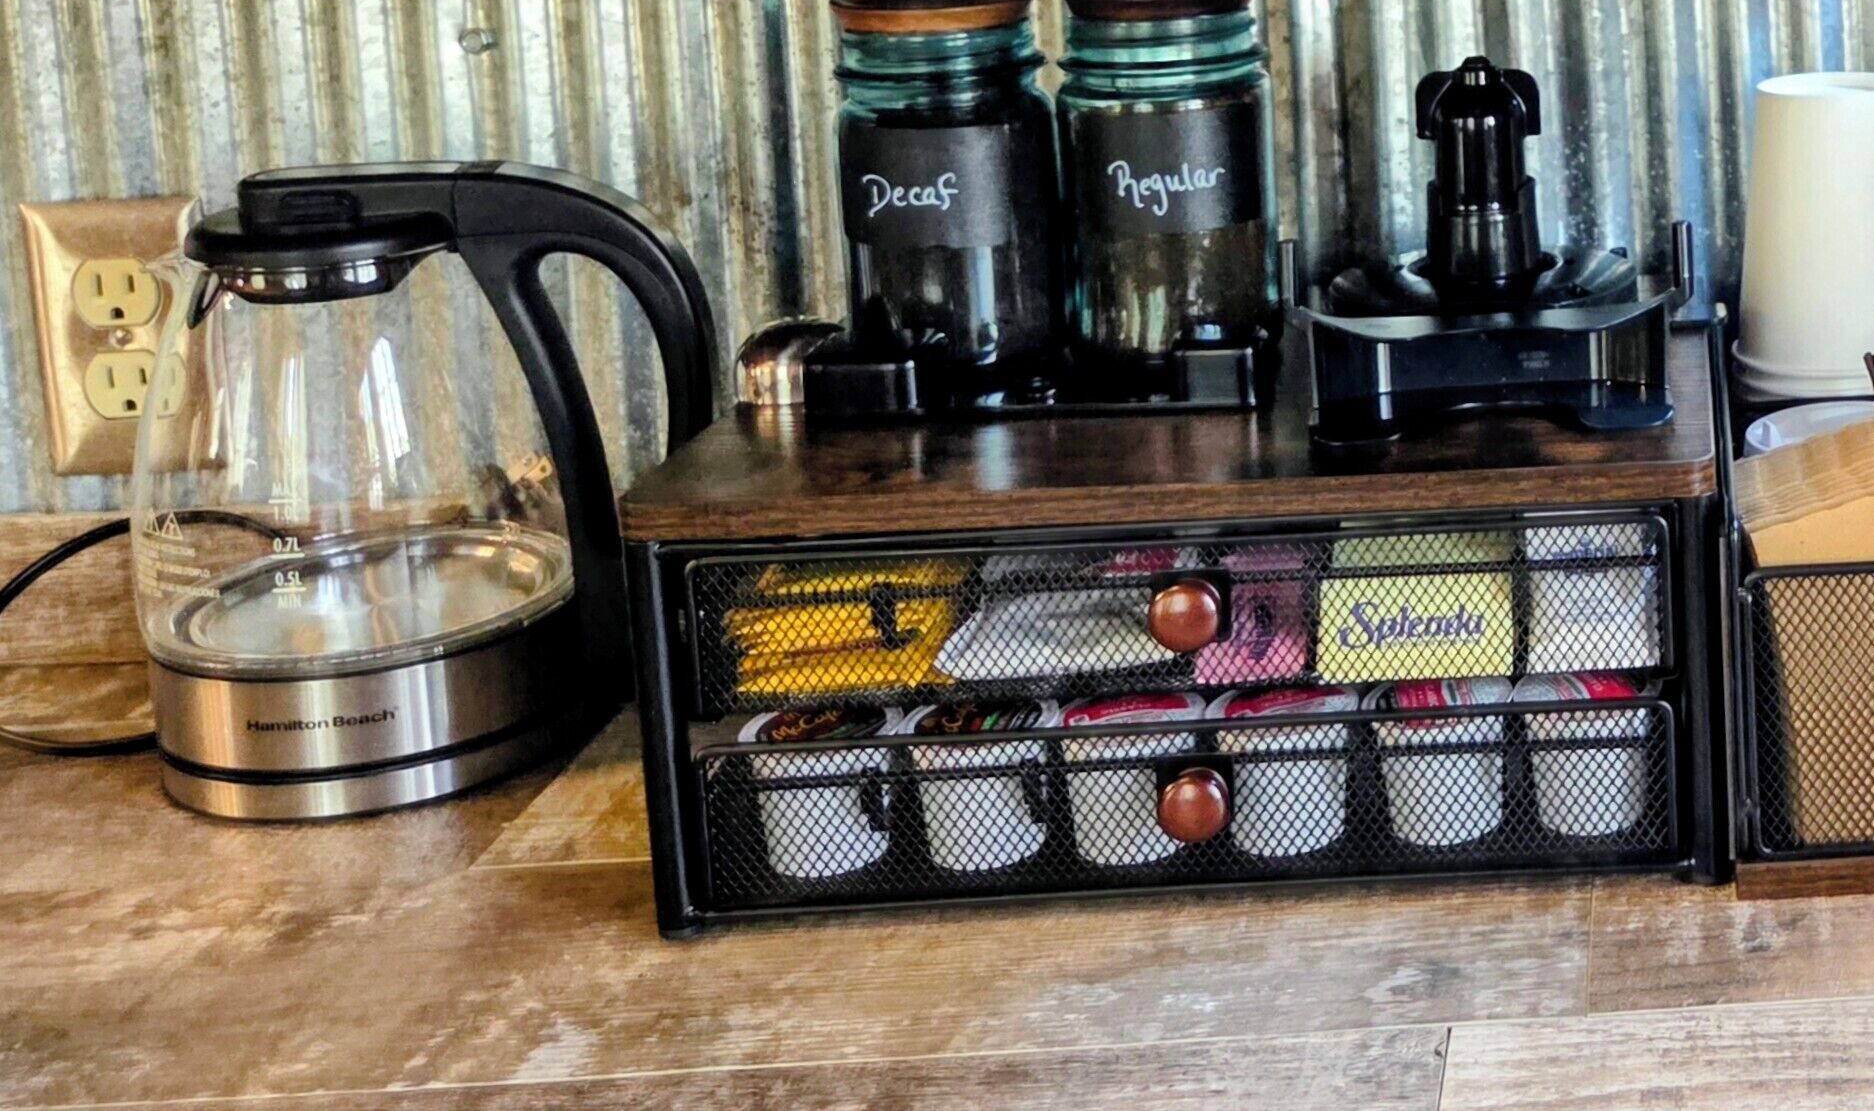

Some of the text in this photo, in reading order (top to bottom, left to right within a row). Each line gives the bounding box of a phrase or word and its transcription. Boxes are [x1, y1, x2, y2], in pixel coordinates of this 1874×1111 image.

[862, 173, 960, 217] Decaf
[1107, 160, 1226, 216] Regular
[273, 538, 301, 553] 0.7L
[275, 571, 302, 587] 0.5L
[278, 596, 302, 609] MIN
[1338, 601, 1483, 649] Splenda
[246, 709, 396, 732] Hamilton Beach
